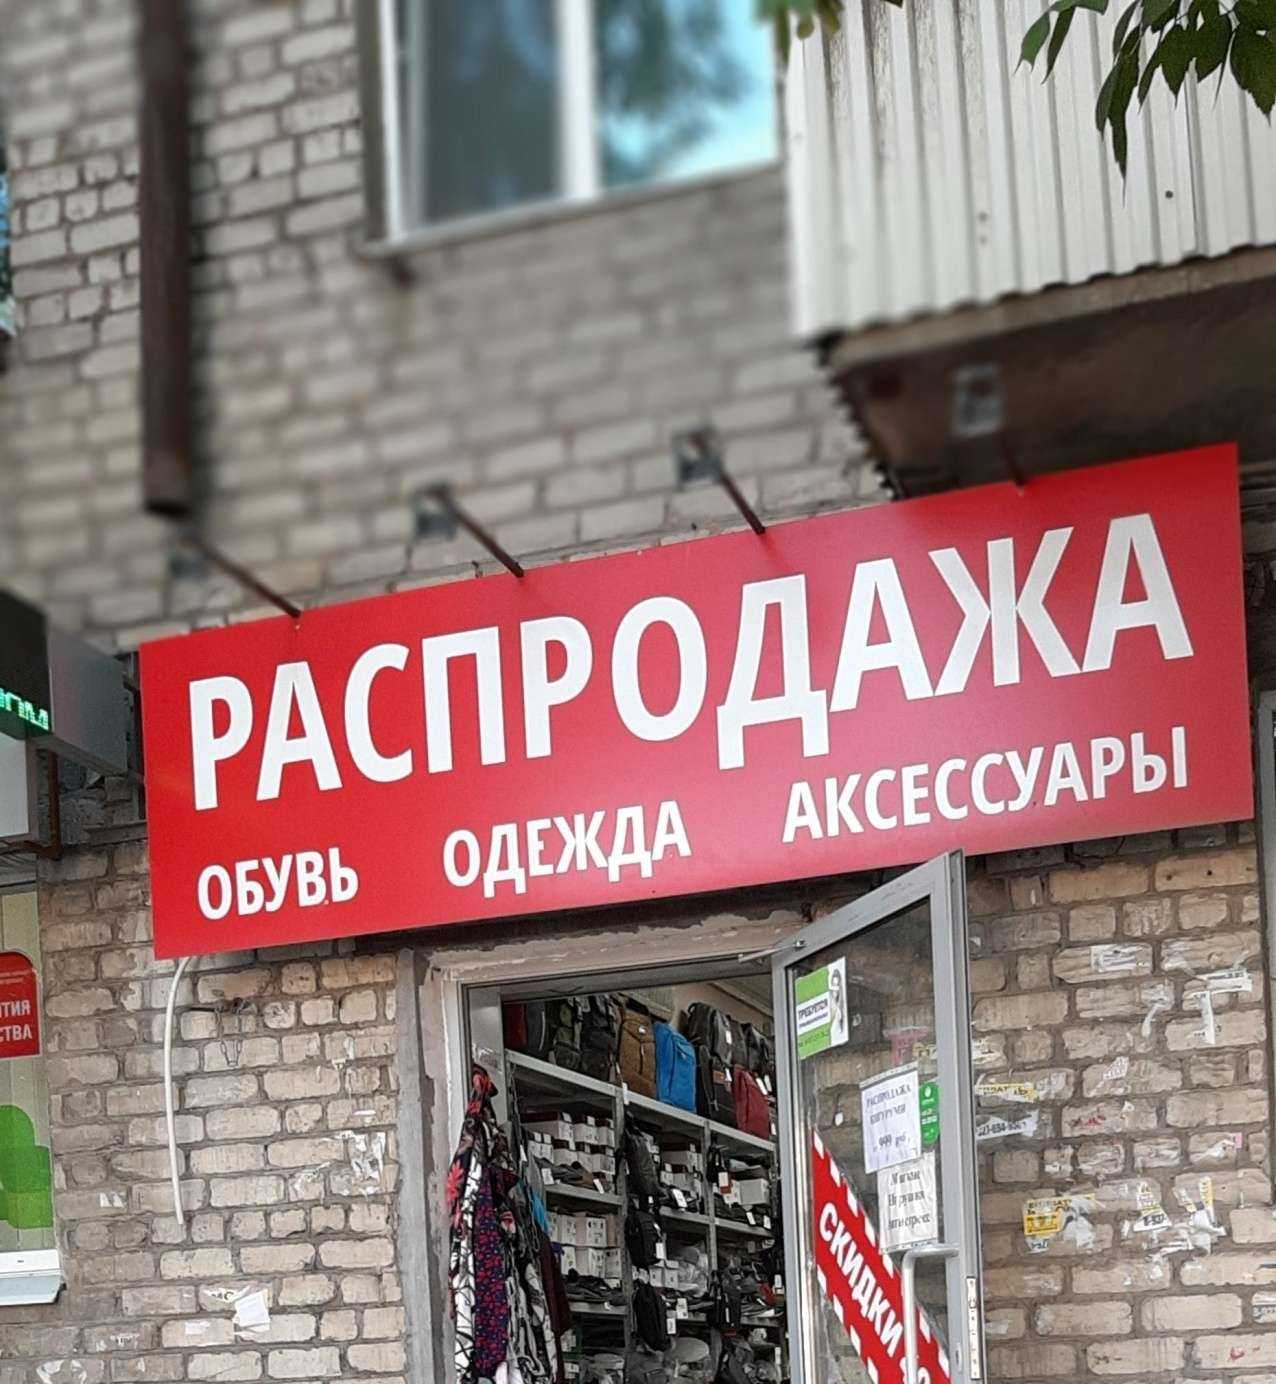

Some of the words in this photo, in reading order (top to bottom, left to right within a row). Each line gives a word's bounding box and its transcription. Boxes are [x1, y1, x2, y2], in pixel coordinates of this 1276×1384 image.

[189, 513, 1194, 812] РАСПРОДАЖА
[197, 847, 359, 920] ОБУВЬ
[443, 801, 692, 899] ОДЕЖДА
[782, 726, 1188, 844] АКСЕССУАРЫ
[819, 1202, 904, 1359] СКИДКИ
